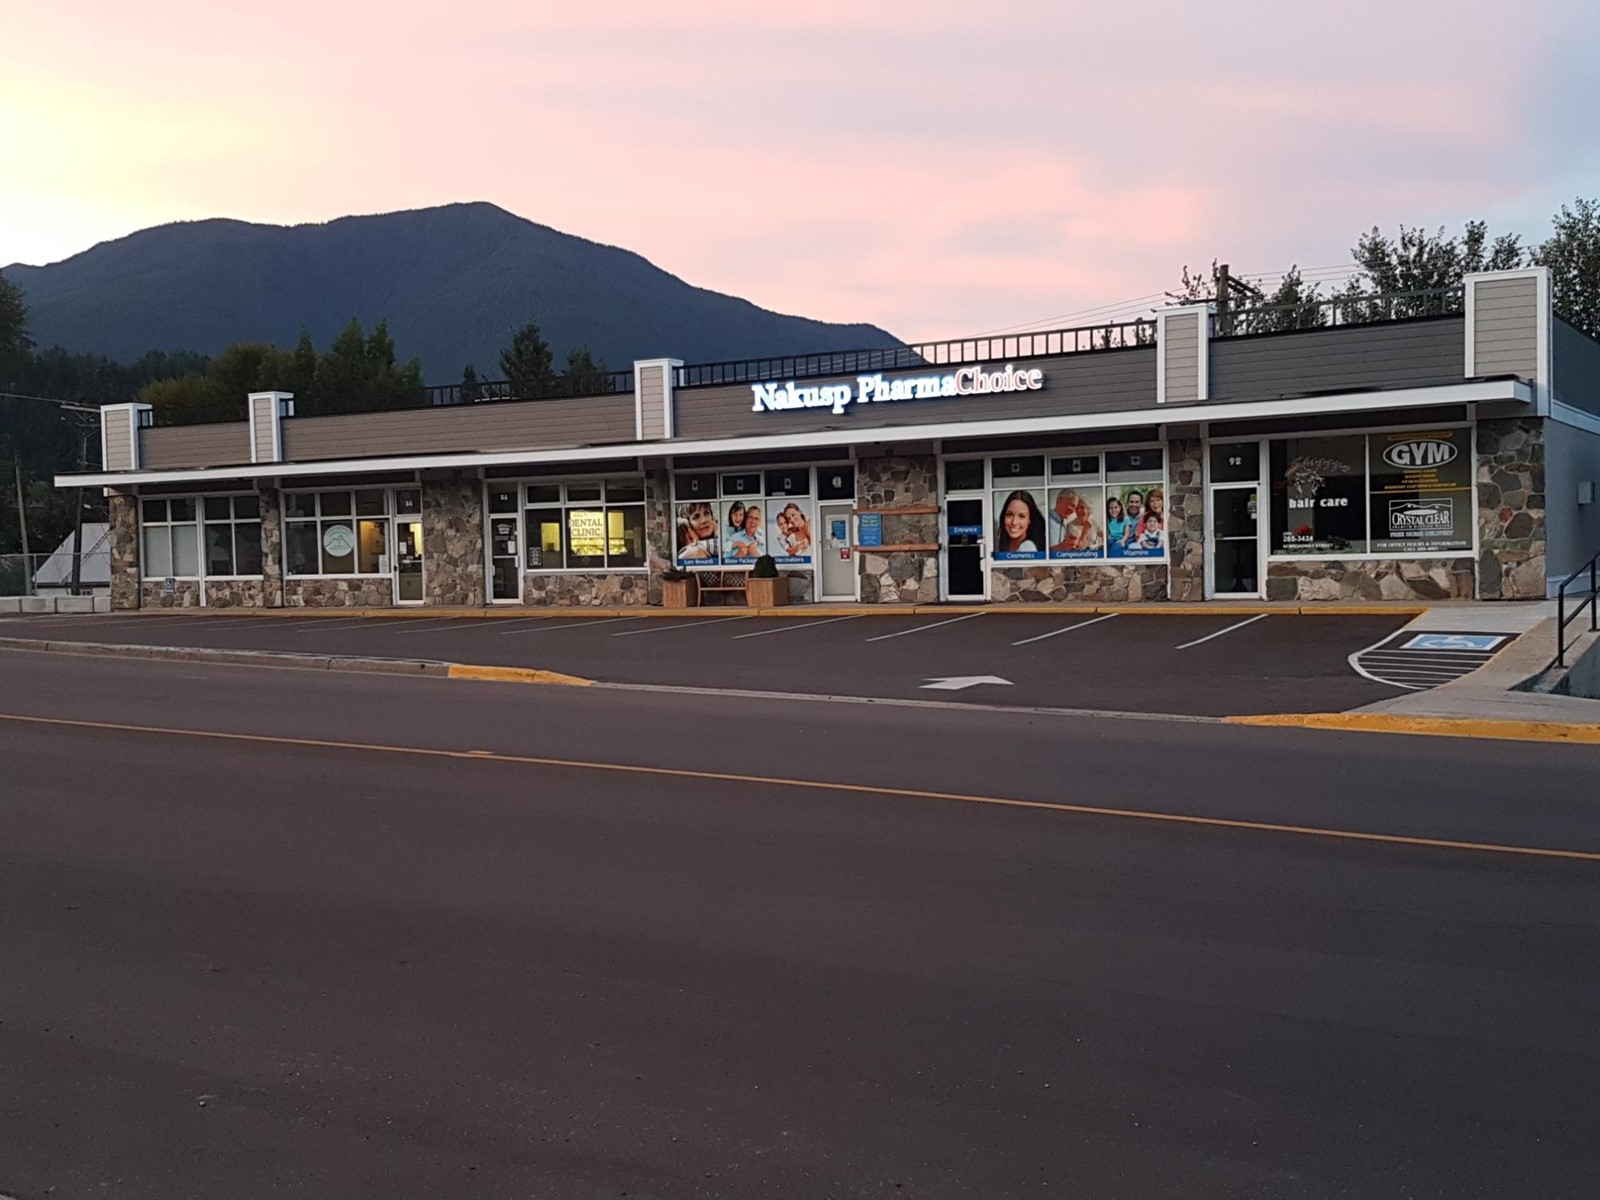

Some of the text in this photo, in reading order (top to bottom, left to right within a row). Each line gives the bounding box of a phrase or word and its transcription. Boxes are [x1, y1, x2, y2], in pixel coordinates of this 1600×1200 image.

[752, 365, 1042, 414] Nakusp PharmaChoice
[1391, 442, 1449, 465] GYM
[1288, 497, 1348, 508] hair care
[569, 519, 602, 527] DENTAL
[1392, 511, 1449, 525] CRYSTAL CLEAR
[572, 528, 600, 536] CLINIC
[1056, 551, 1098, 559] Compounding
